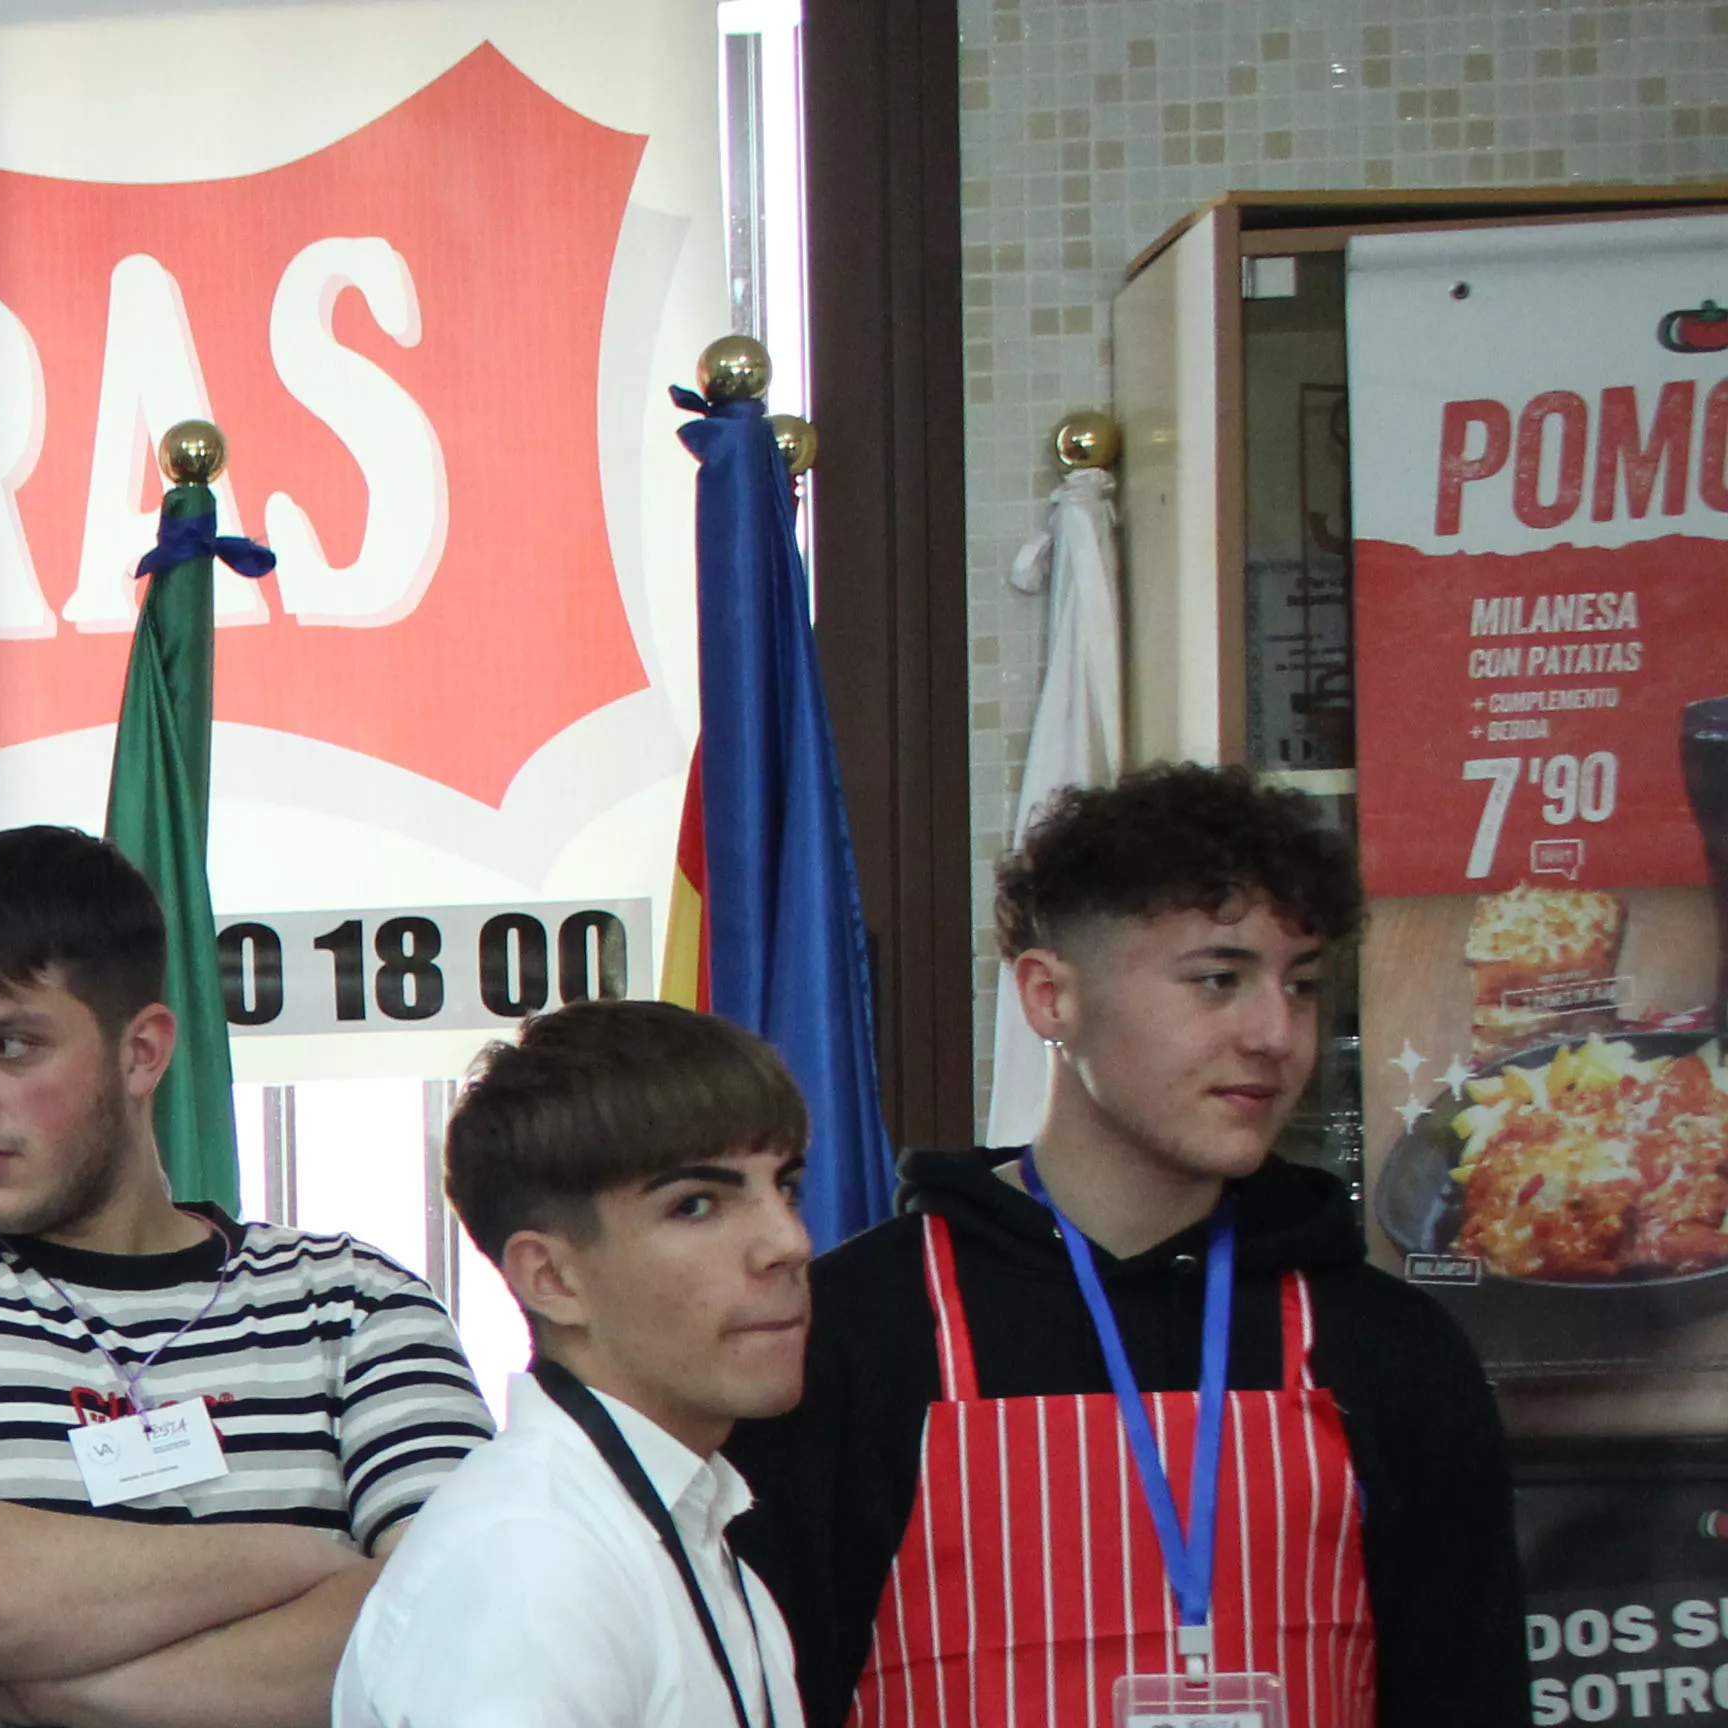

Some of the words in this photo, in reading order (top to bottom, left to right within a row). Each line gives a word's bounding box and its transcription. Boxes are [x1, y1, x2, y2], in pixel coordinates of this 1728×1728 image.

[1470, 591, 1639, 637] MILANESA
[1469, 647, 1520, 679] CON
[1527, 641, 1643, 676] PATATAS
[1489, 687, 1620, 713] COMPLEMENTO
[1487, 718, 1549, 741] BEBIDA
[1463, 751, 1619, 879] 7'90
[313, 916, 445, 1022] 18
[478, 910, 628, 1018] 00
